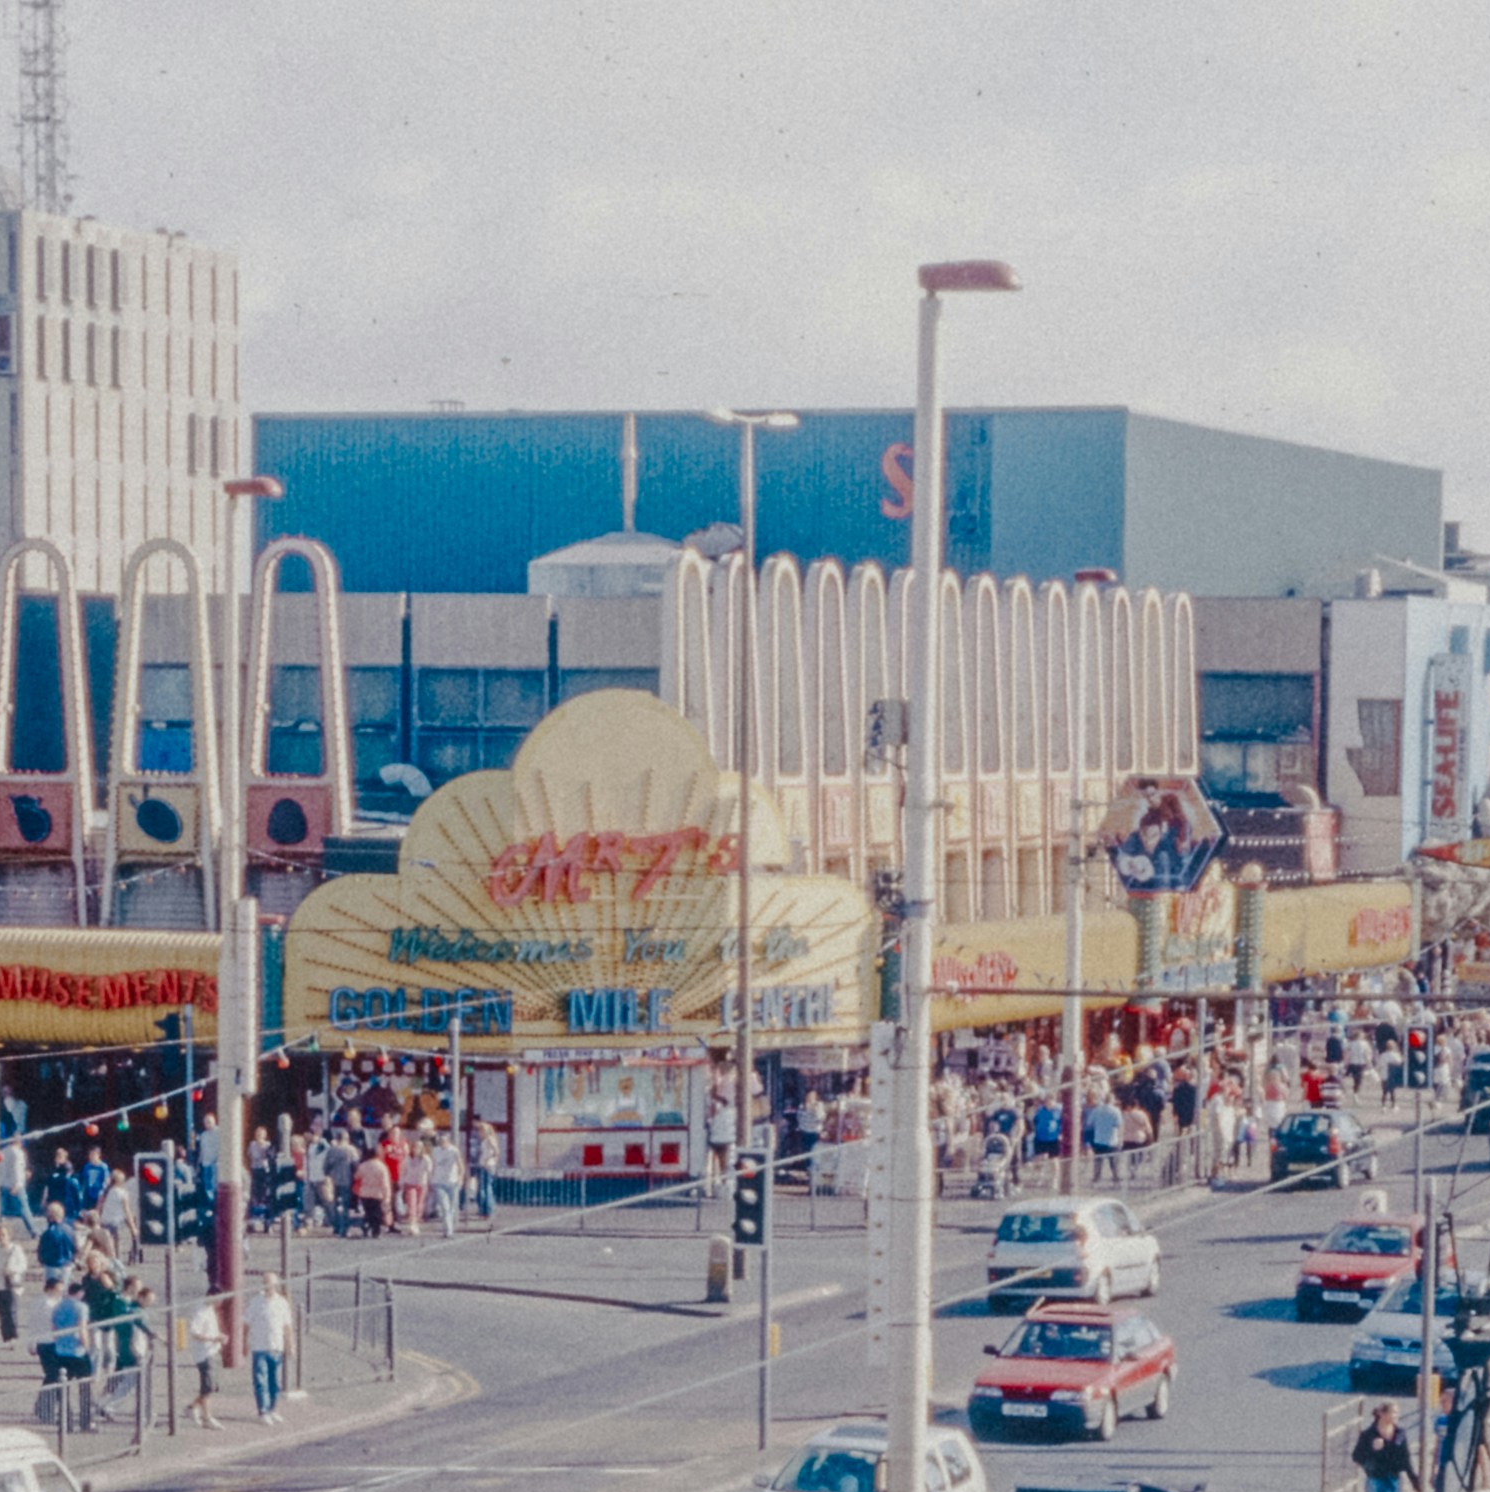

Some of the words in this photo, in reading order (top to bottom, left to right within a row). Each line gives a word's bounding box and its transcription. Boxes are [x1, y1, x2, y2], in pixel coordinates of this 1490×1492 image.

[622, 926, 686, 964] You
[329, 985, 514, 1034] GOLDEN
[567, 986, 673, 1034] MILE
